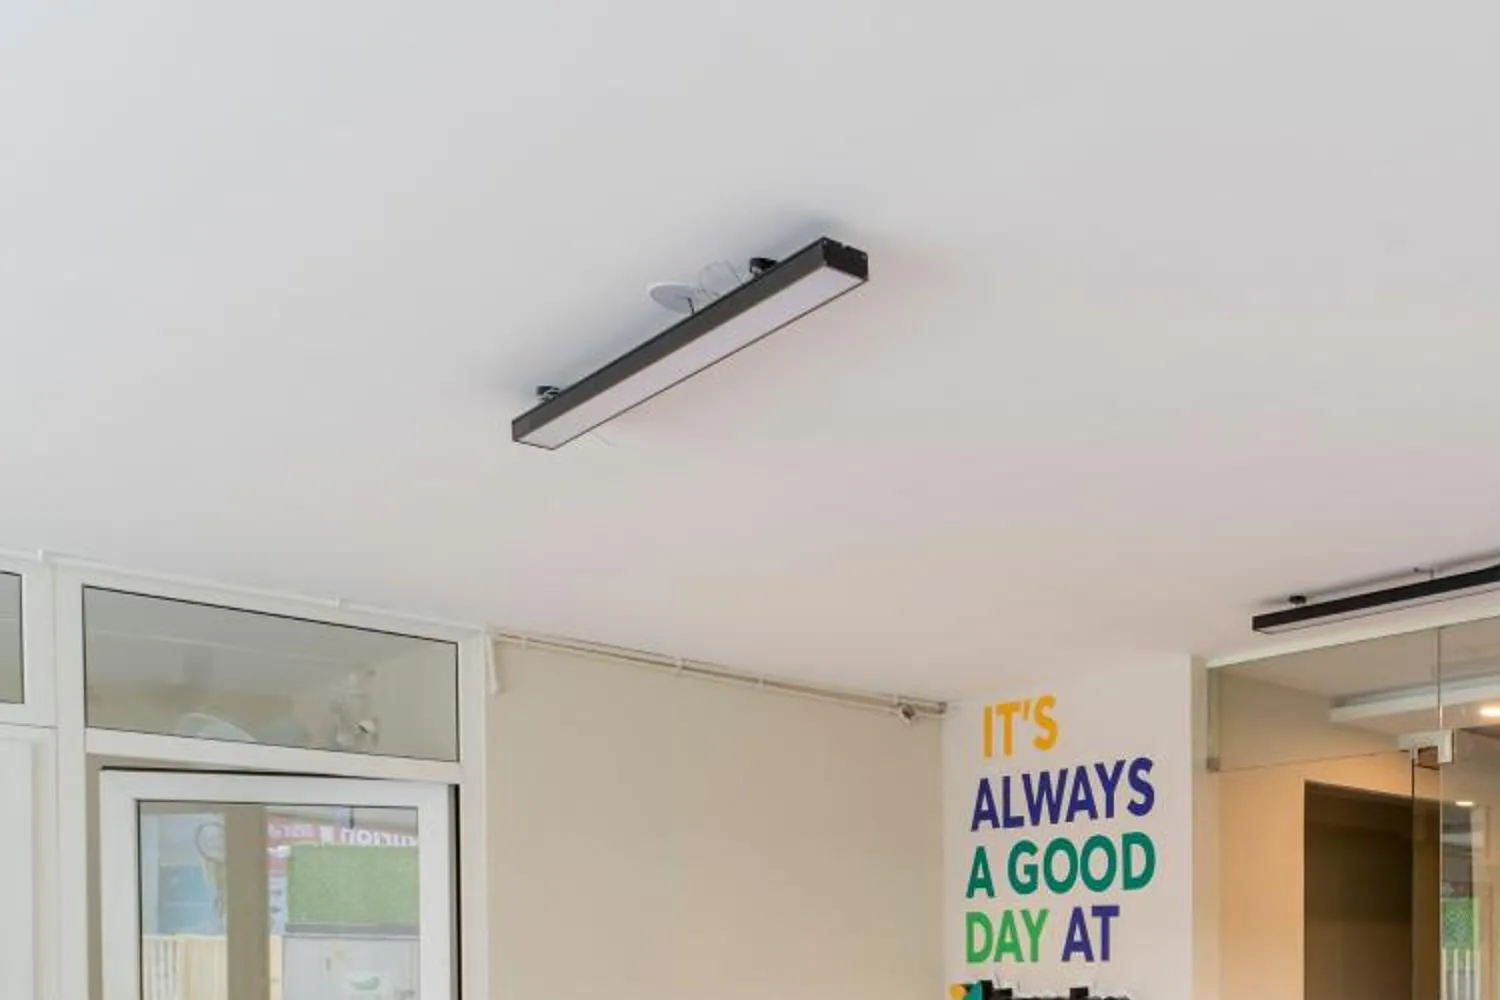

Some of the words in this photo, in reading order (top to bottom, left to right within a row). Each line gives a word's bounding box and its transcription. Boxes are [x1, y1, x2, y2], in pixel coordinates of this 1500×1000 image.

[982, 695, 1058, 758] IT'S
[970, 757, 1155, 832] ALWAYS
[965, 846, 996, 898] A
[1008, 831, 1156, 895] GOOD
[965, 908, 1049, 963] DAY
[1061, 904, 1120, 962] AT
